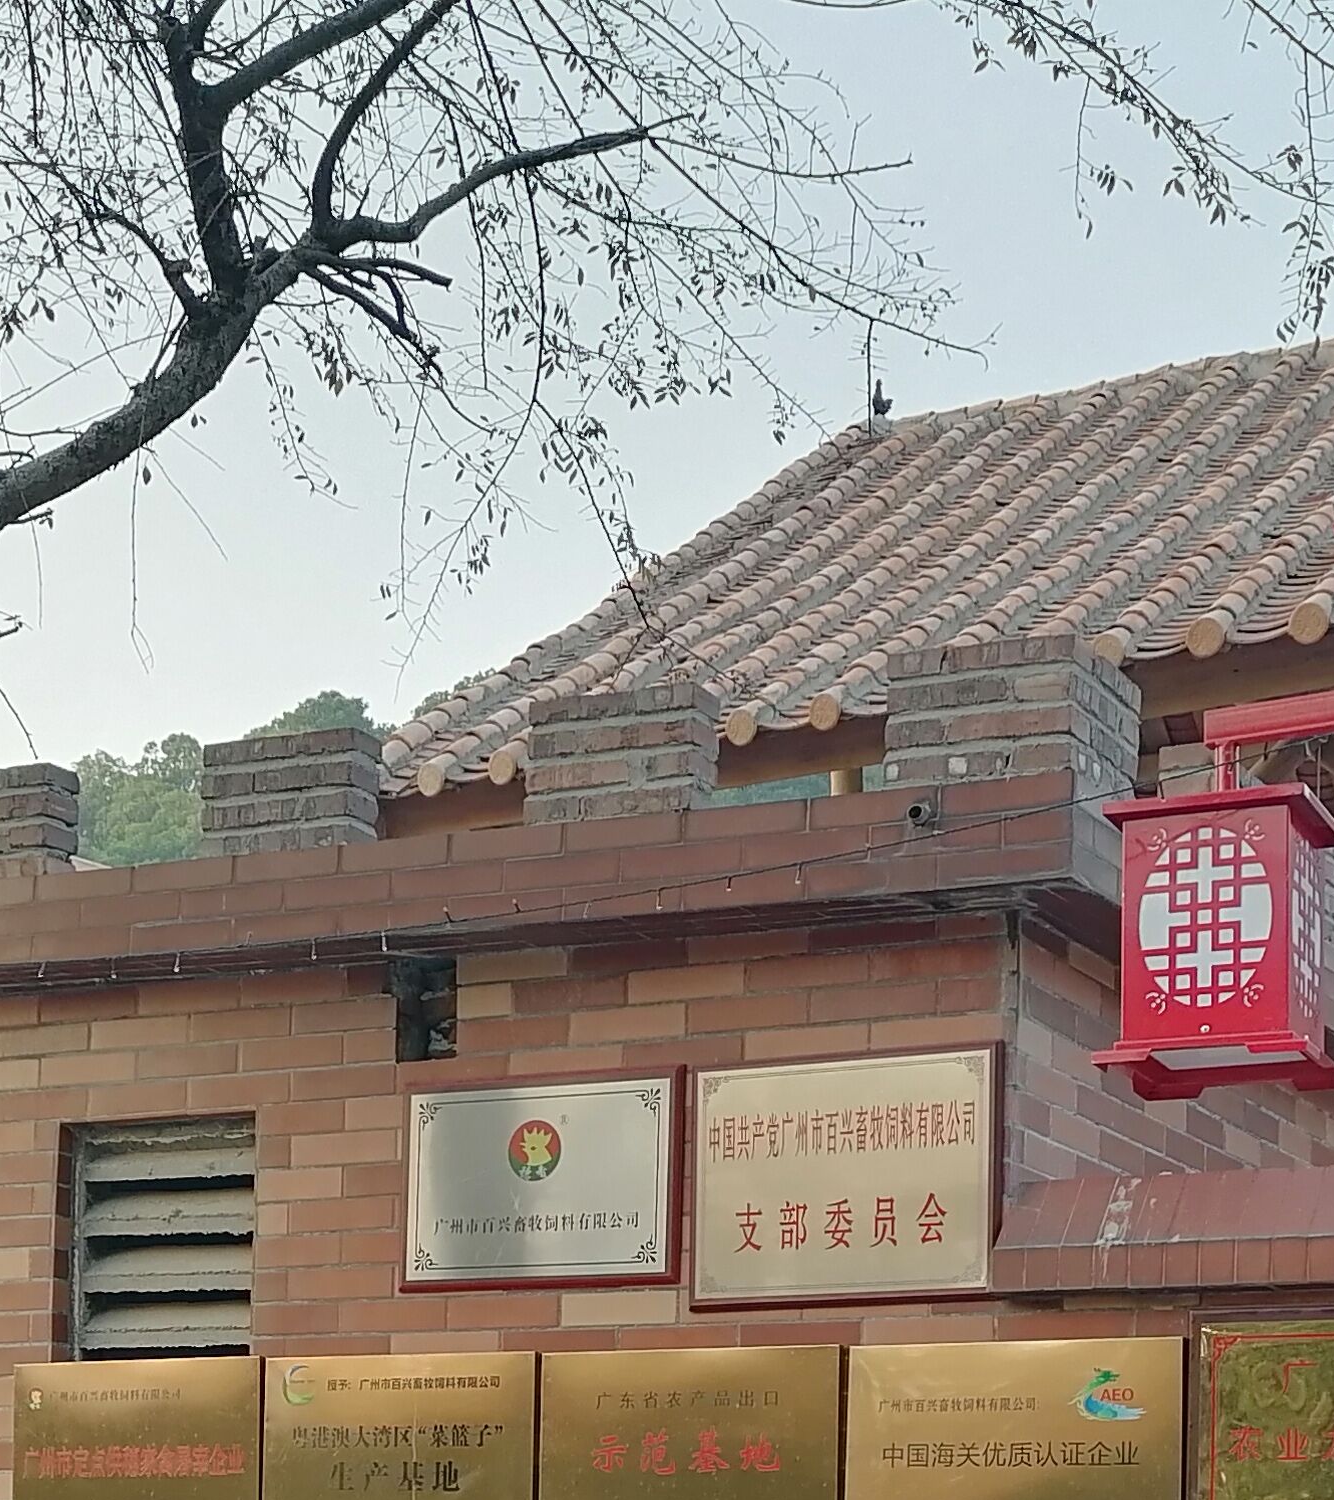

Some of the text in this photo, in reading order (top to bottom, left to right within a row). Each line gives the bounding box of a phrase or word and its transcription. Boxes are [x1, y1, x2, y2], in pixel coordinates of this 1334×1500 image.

[708, 1100, 976, 1163] 中国共产党广州市百兴畜牧饲料有限公司
[433, 1211, 640, 1236] 广州市百兴畜牧饲料有限公司
[734, 1192, 948, 1253] 支部委员会
[359, 1375, 501, 1391] 广州市百兴畜牧饲料有限公司
[1100, 1388, 1134, 1401] AEO
[595, 1390, 779, 1410] 广东省农产品出口
[591, 1425, 781, 1476] 示范基地
[882, 1441, 1140, 1468] 中国海关优质认证企业
[330, 1460, 460, 1492] 生产基地
